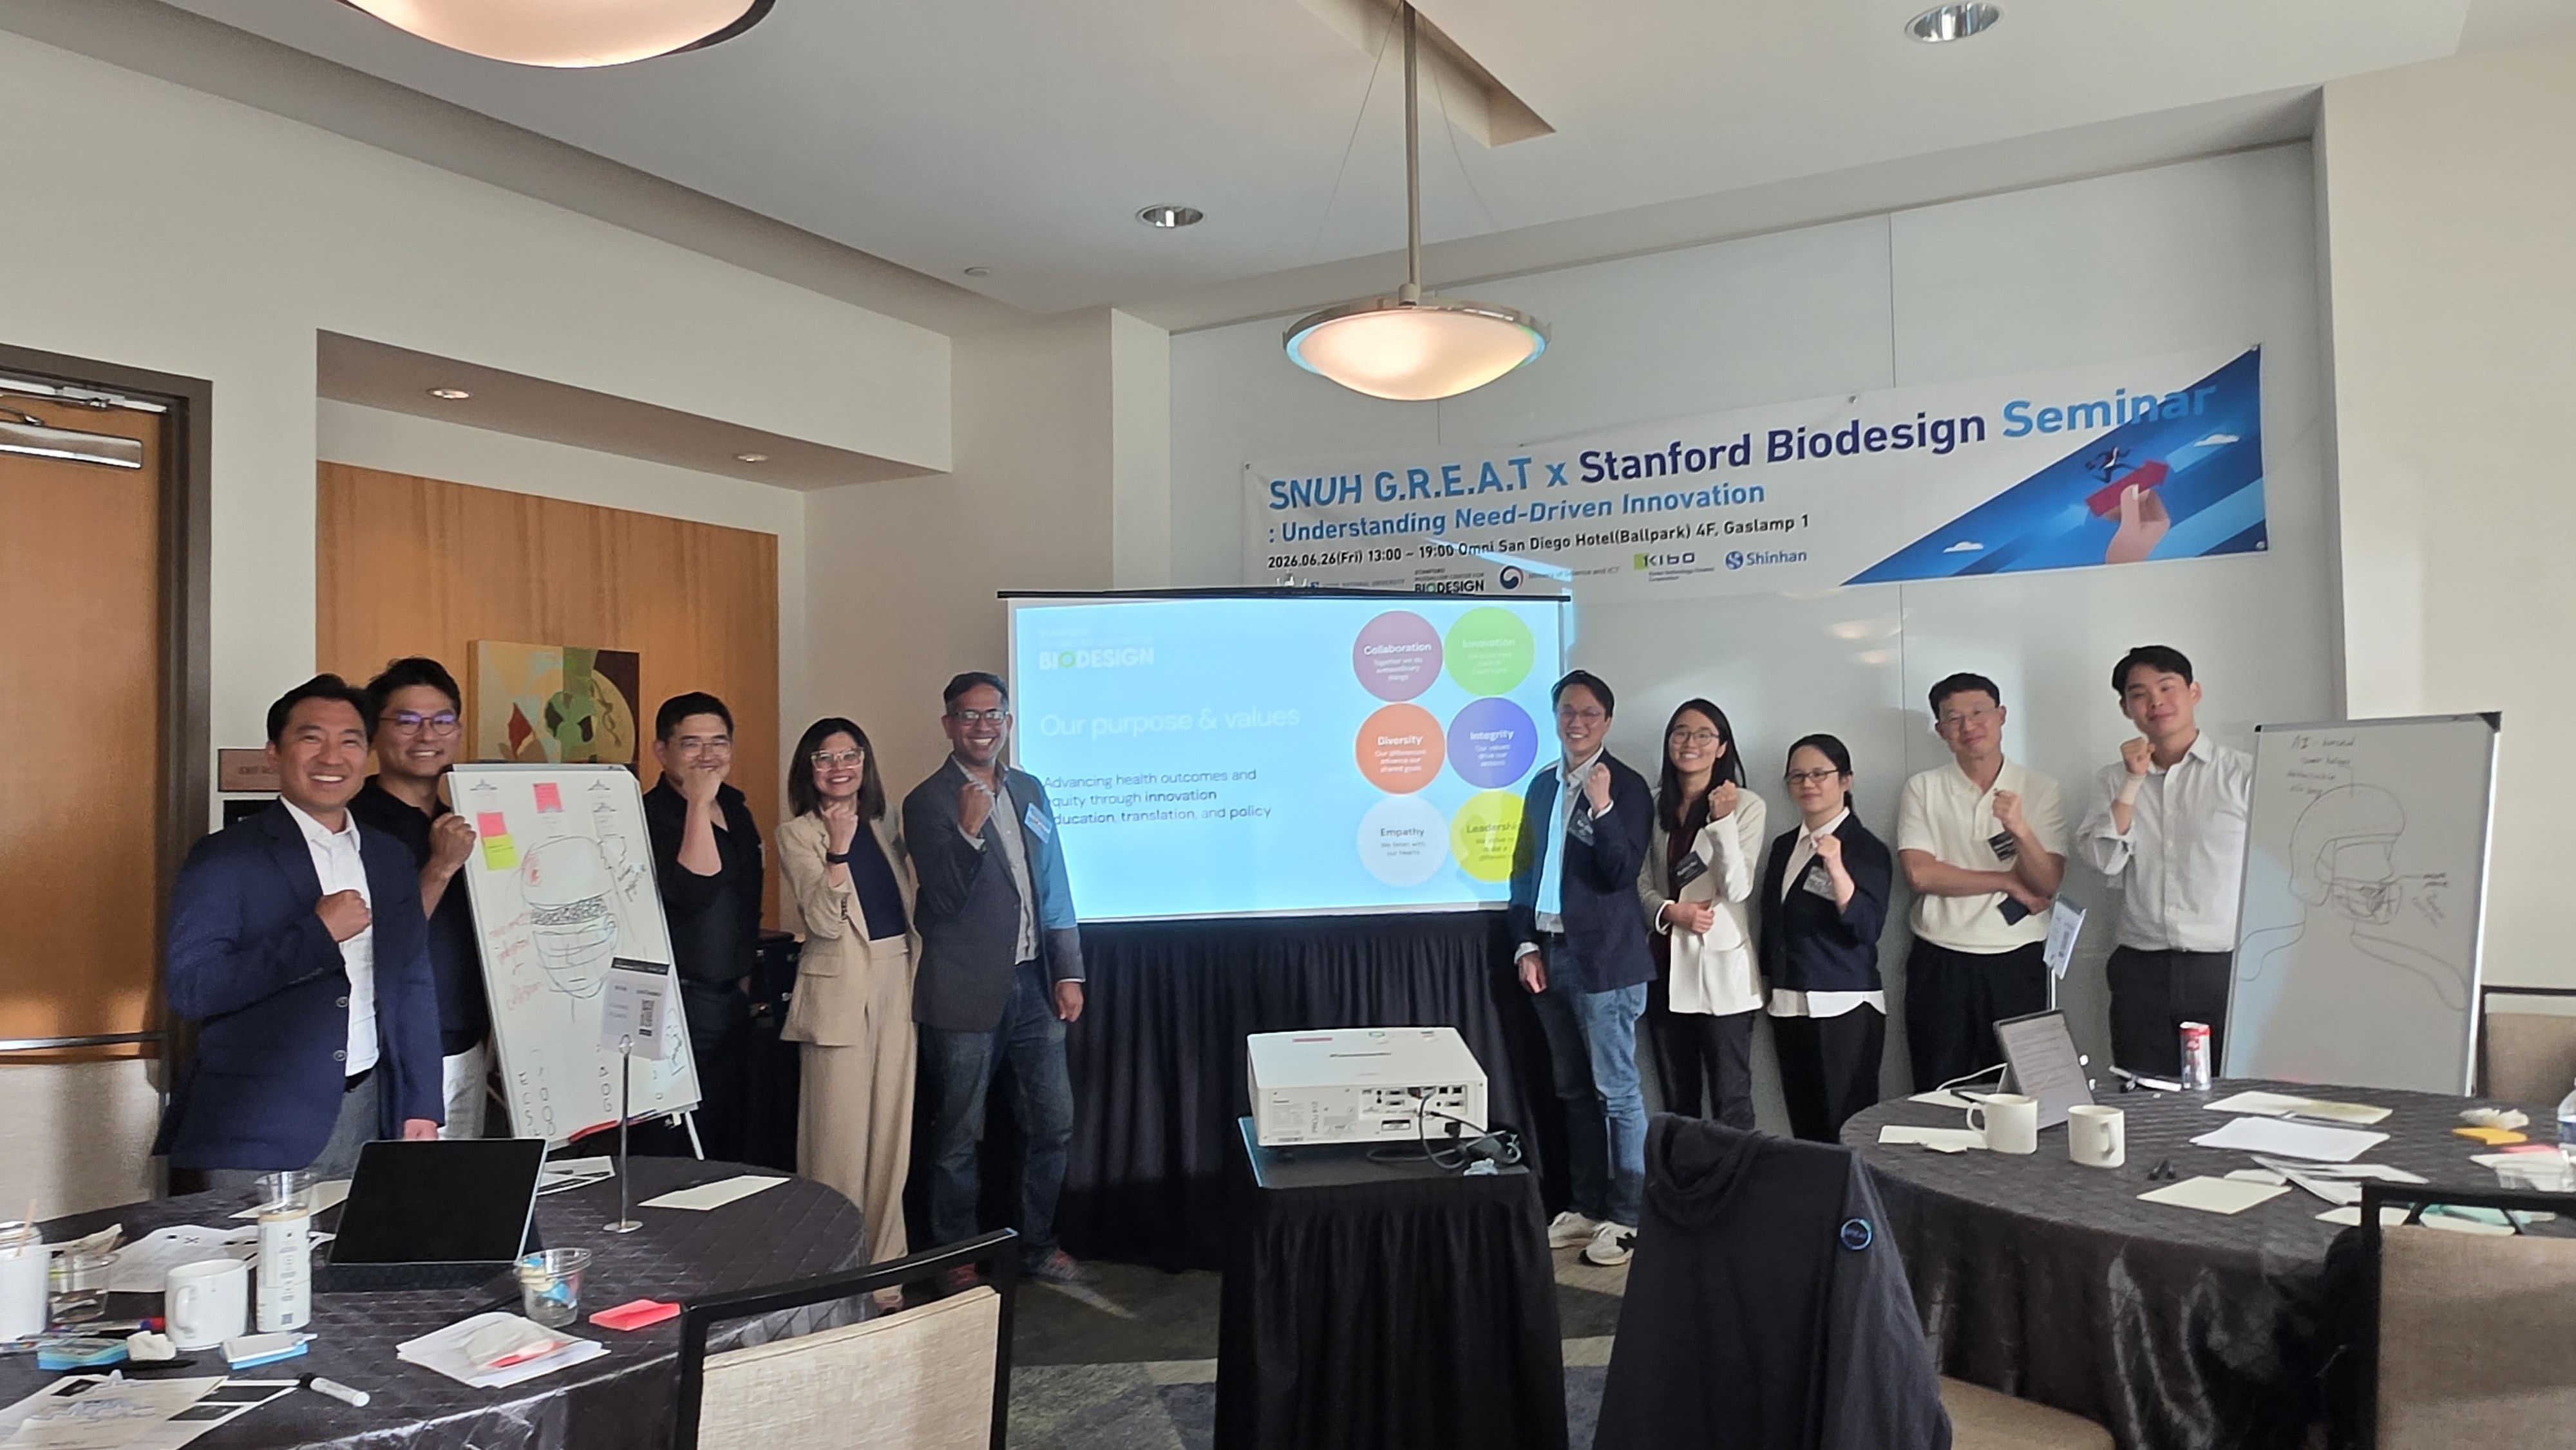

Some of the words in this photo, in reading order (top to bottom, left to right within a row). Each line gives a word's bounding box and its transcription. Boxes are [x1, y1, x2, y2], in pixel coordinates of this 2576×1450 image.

[1269, 474, 1361, 510] SNUH
[1374, 457, 1532, 502] G.R.E.A.T
[1545, 462, 1568, 488] x
[1580, 433, 1750, 483] Stanford
[1766, 412, 1985, 463] Biodesign
[2002, 386, 2217, 438] Seminar
[1282, 512, 1446, 542] Understanding
[1455, 500, 1612, 528] Need-Driven
[1622, 483, 1765, 514] Innovation
[1268, 550, 1363, 569] 2026.06.26(Fri)
[1368, 549, 1401, 563] 13:00
[1419, 545, 1454, 558] 19:00
[1458, 540, 1494, 556] Omni
[1499, 539, 1525, 552] San
[1530, 536, 1571, 552] Diego
[1576, 523, 1690, 547] Hotel(Ballpark)
[1696, 523, 1719, 537] 4F,
[1724, 517, 1795, 535] Gaslamp
[1801, 514, 1808, 527] 1
[1746, 550, 1807, 567] Shinhan
[1415, 579, 1484, 593] BIODESIGN
[1363, 642, 1432, 655] Collaboration
[1039, 647, 1154, 670] BIODESIGN
[1040, 714, 1086, 737] Our
[1092, 715, 1192, 740] purpose
[1198, 708, 1218, 730] &
[1224, 706, 1300, 729] values
[1378, 735, 1423, 746] Diversity
[1470, 730, 1515, 742] Integrity
[1043, 776, 1112, 789] Advancing
[1116, 773, 1157, 785] health
[1160, 771, 1227, 784] outcomes
[1232, 769, 1256, 780] and
[1050, 795, 1086, 808] quity
[1090, 793, 1141, 807] through
[1145, 789, 1217, 802] innovation
[1054, 812, 1117, 825] ducation,
[1202, 807, 1226, 819] and
[1229, 805, 1271, 820] policy
[1381, 827, 1425, 838] Empathy
